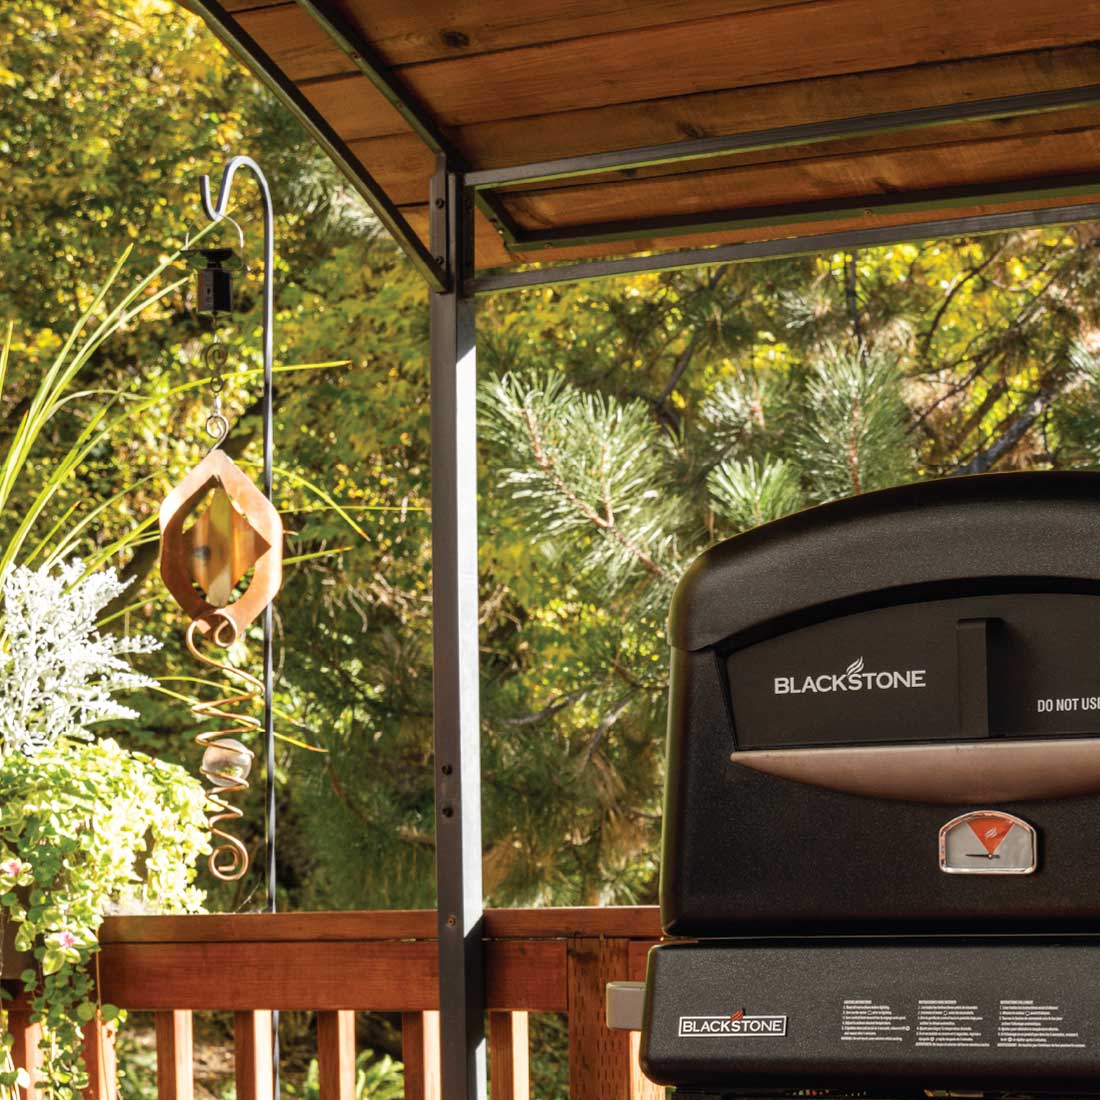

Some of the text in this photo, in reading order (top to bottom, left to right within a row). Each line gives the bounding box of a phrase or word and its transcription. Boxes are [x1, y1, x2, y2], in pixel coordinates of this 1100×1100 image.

[774, 669, 927, 695] BLACKSTONE
[1037, 699, 1054, 713] DO
[1056, 697, 1080, 712] NOT
[682, 1020, 783, 1032] BLACKSTONE
